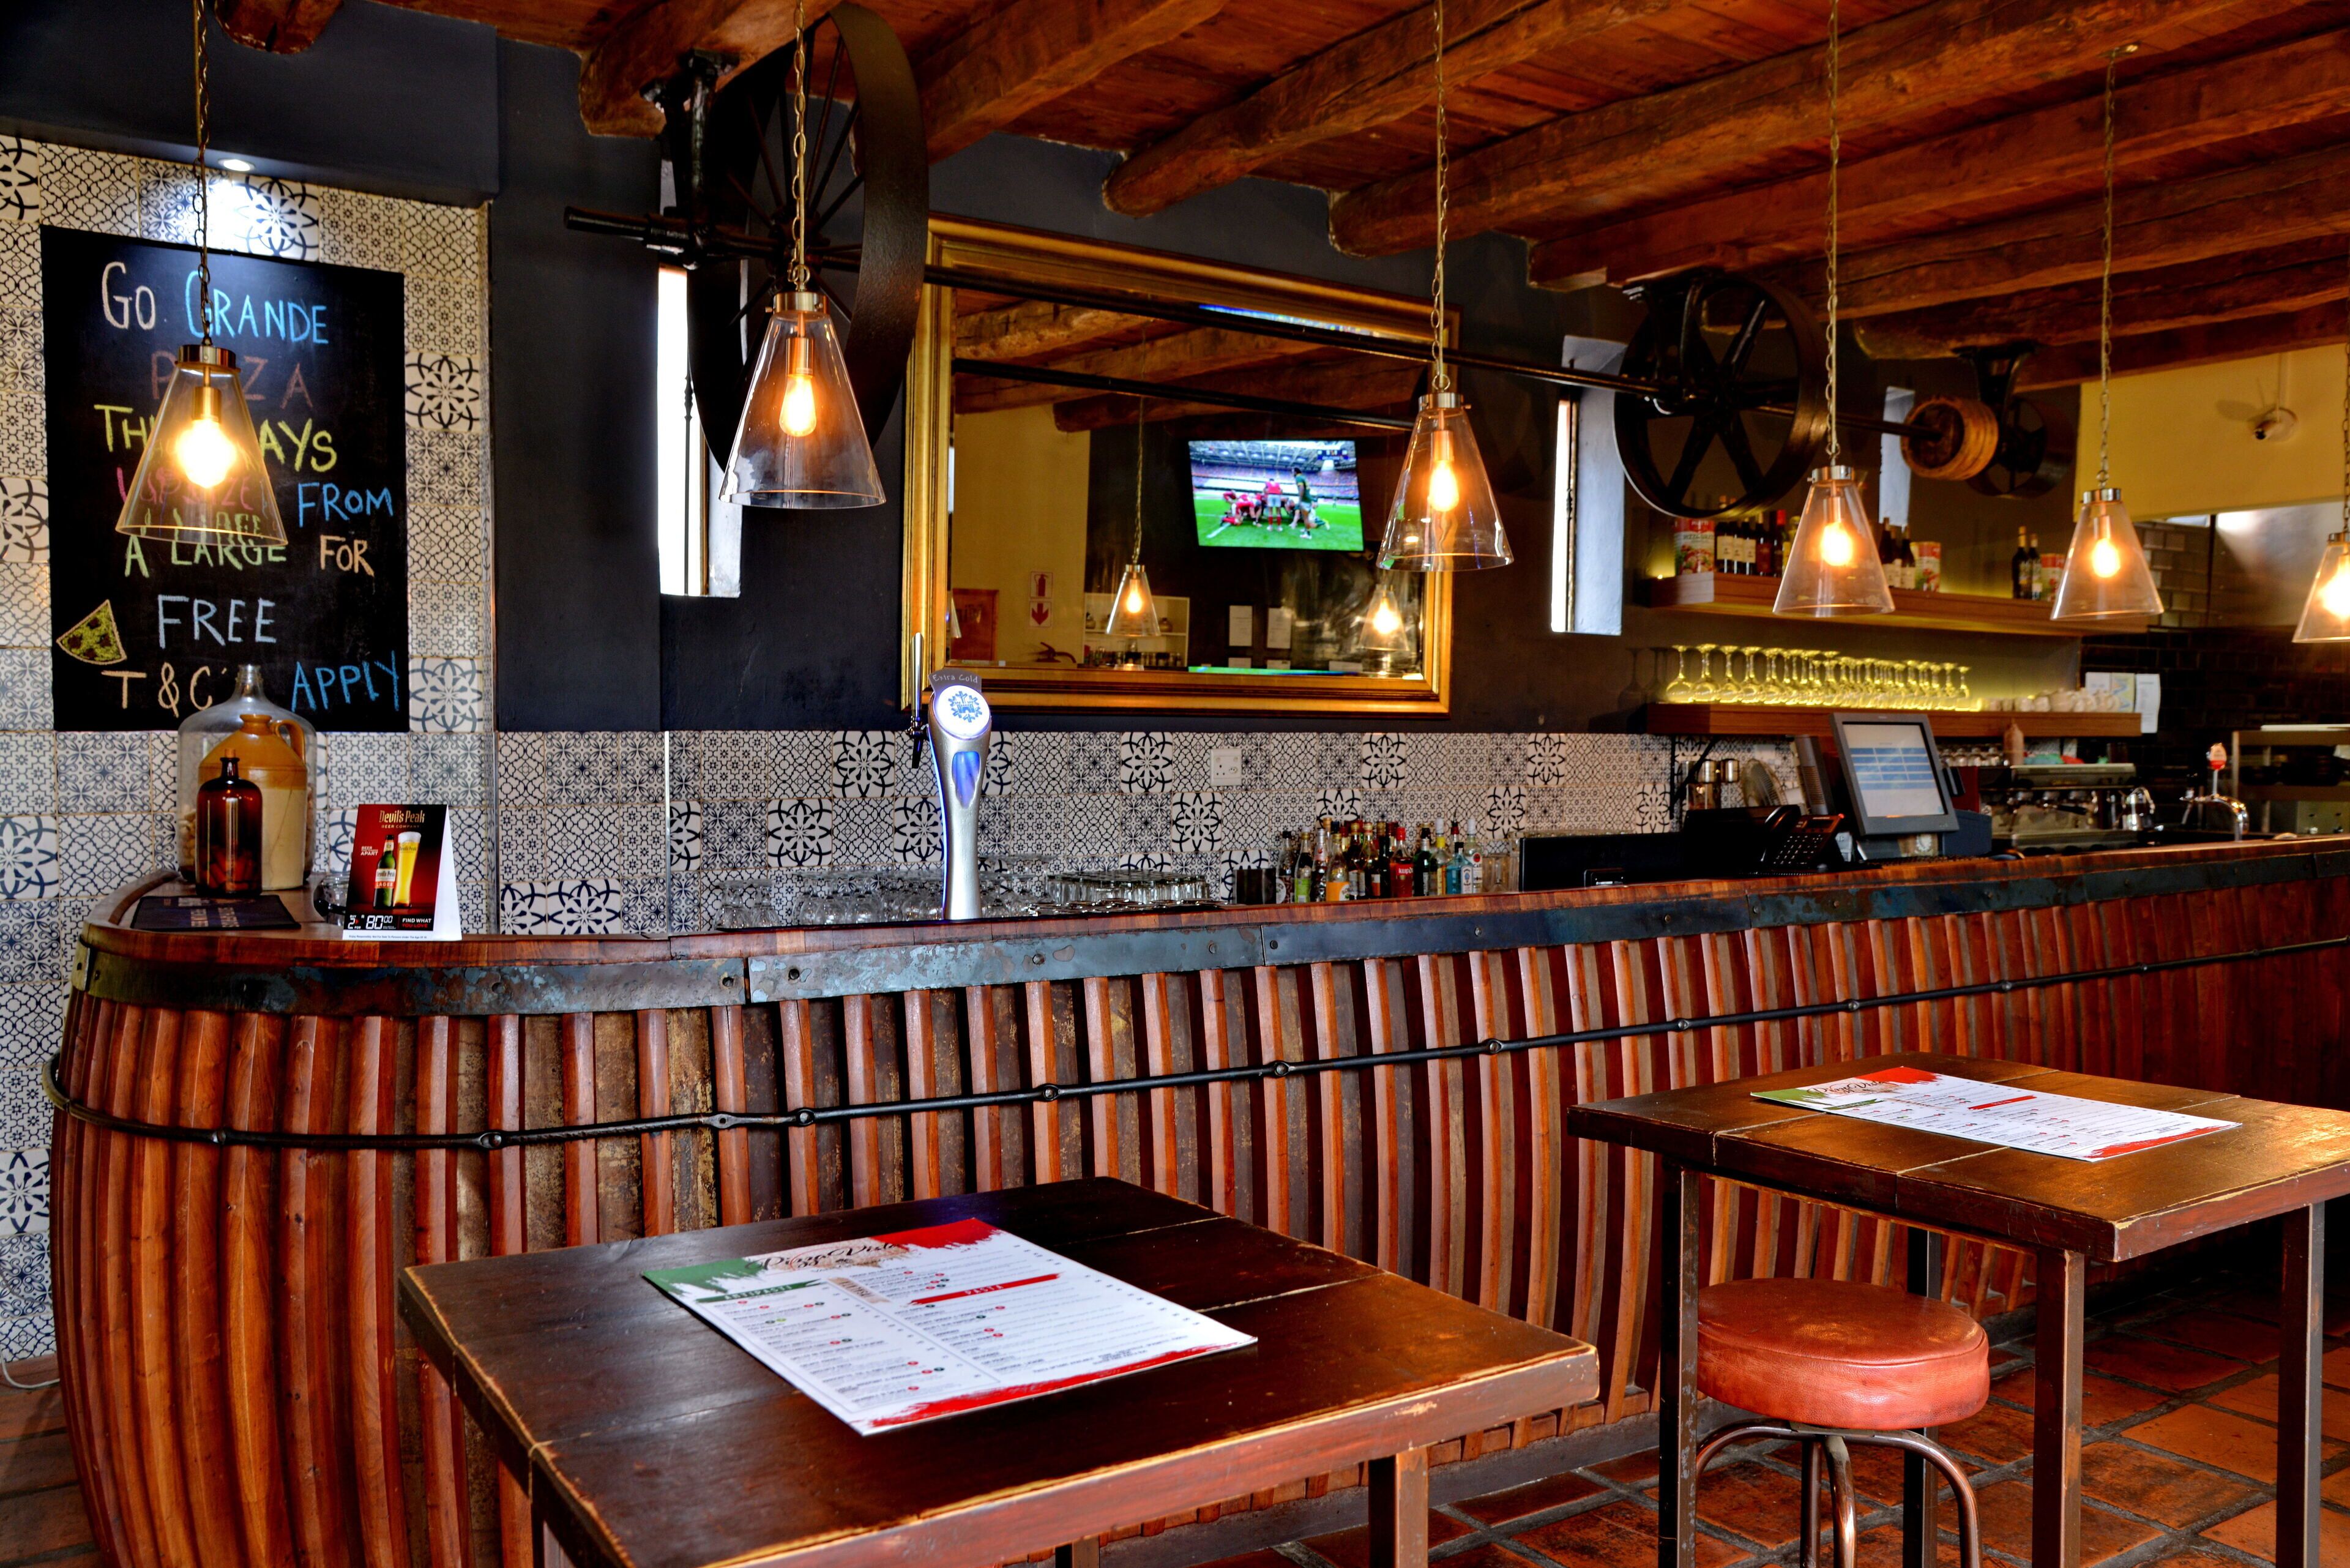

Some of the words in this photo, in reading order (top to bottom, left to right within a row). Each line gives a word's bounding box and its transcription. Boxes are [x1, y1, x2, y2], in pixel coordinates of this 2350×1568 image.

[185, 270, 329, 345] GRANDE
[151, 350, 313, 409] PZA
[94, 404, 337, 472] THAYS
[297, 482, 394, 528] FROM
[171, 525, 288, 570] LARGE
[319, 534, 375, 578] FOR
[157, 594, 277, 649] FREE
[291, 650, 400, 712] APPLY
[959, 674, 978, 684] Cold
[379, 810, 404, 823] Devil's
[405, 810, 425, 823] Peak
[348, 918, 356, 930] 2
[964, 1284, 1005, 1296] PASTA
